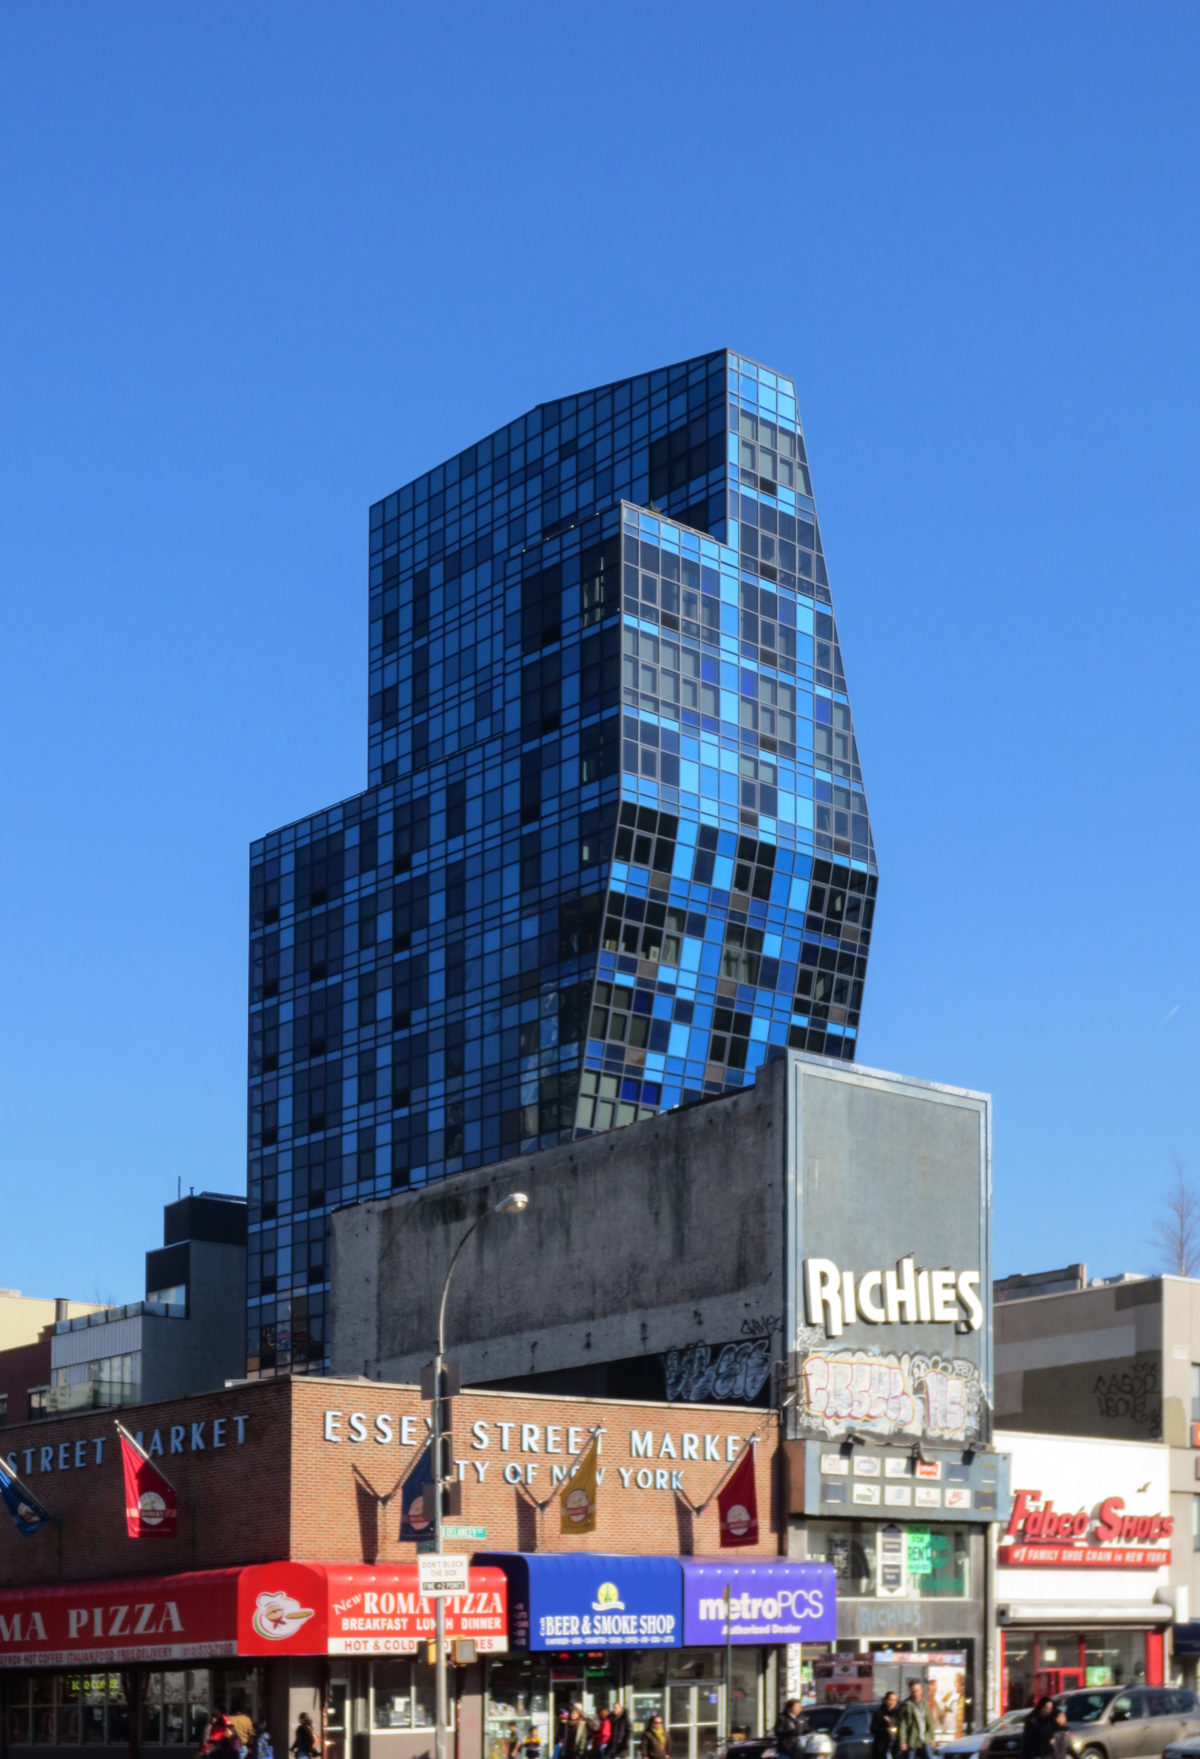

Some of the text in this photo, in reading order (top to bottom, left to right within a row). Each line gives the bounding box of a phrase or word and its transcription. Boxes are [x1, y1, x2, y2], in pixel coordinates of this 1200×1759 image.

[472, 1420, 607, 1455] STREET
[6, 1437, 107, 1475] STREET
[503, 1461, 539, 1484] OF
[618, 1466, 684, 1490] YORK
[1028, 1548, 1058, 1561] FAMILY
[1061, 1549, 1083, 1561] SHOE
[1085, 1550, 1112, 1562] CHAIN
[1125, 1551, 1144, 1562] NEW
[1146, 1551, 1167, 1563] YORK
[364, 1592, 430, 1615] ROMA
[699, 1590, 824, 1620] metroPCS
[67, 1602, 184, 1638] PIZZA
[341, 1617, 502, 1631] BREAKFAST LUNH DINNER
[546, 1616, 580, 1635] BEER
[581, 1615, 592, 1635] &
[593, 1615, 638, 1635] SMOKE
[640, 1615, 675, 1634] SHOP
[345, 1640, 368, 1651] HOT
[373, 1640, 380, 1651] &
[384, 1640, 415, 1650] COLD
